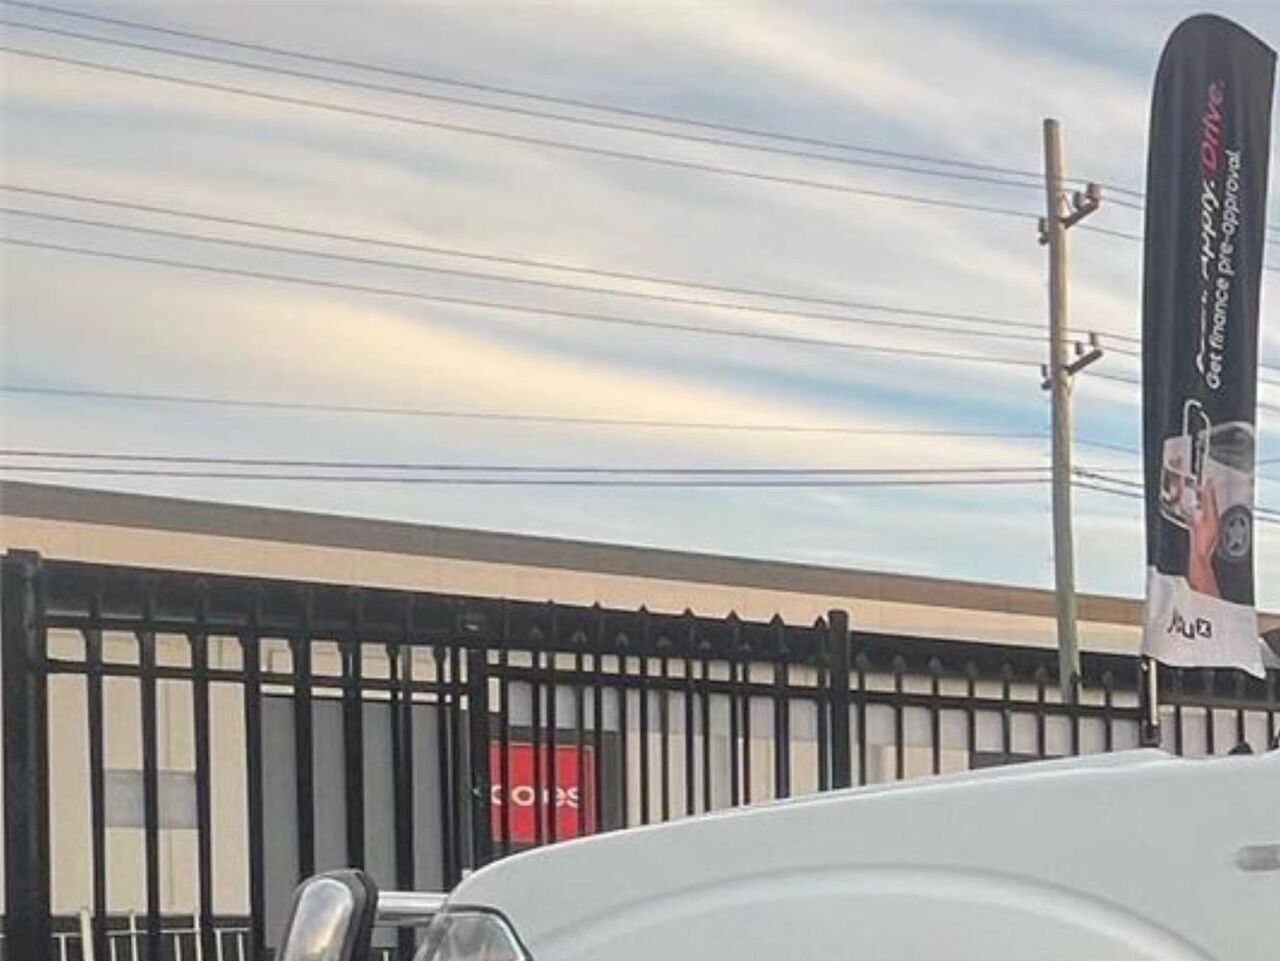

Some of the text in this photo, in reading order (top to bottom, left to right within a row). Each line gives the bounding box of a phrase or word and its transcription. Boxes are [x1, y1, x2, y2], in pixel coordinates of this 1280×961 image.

[1206, 150, 1240, 389] Get finance pre-approval
